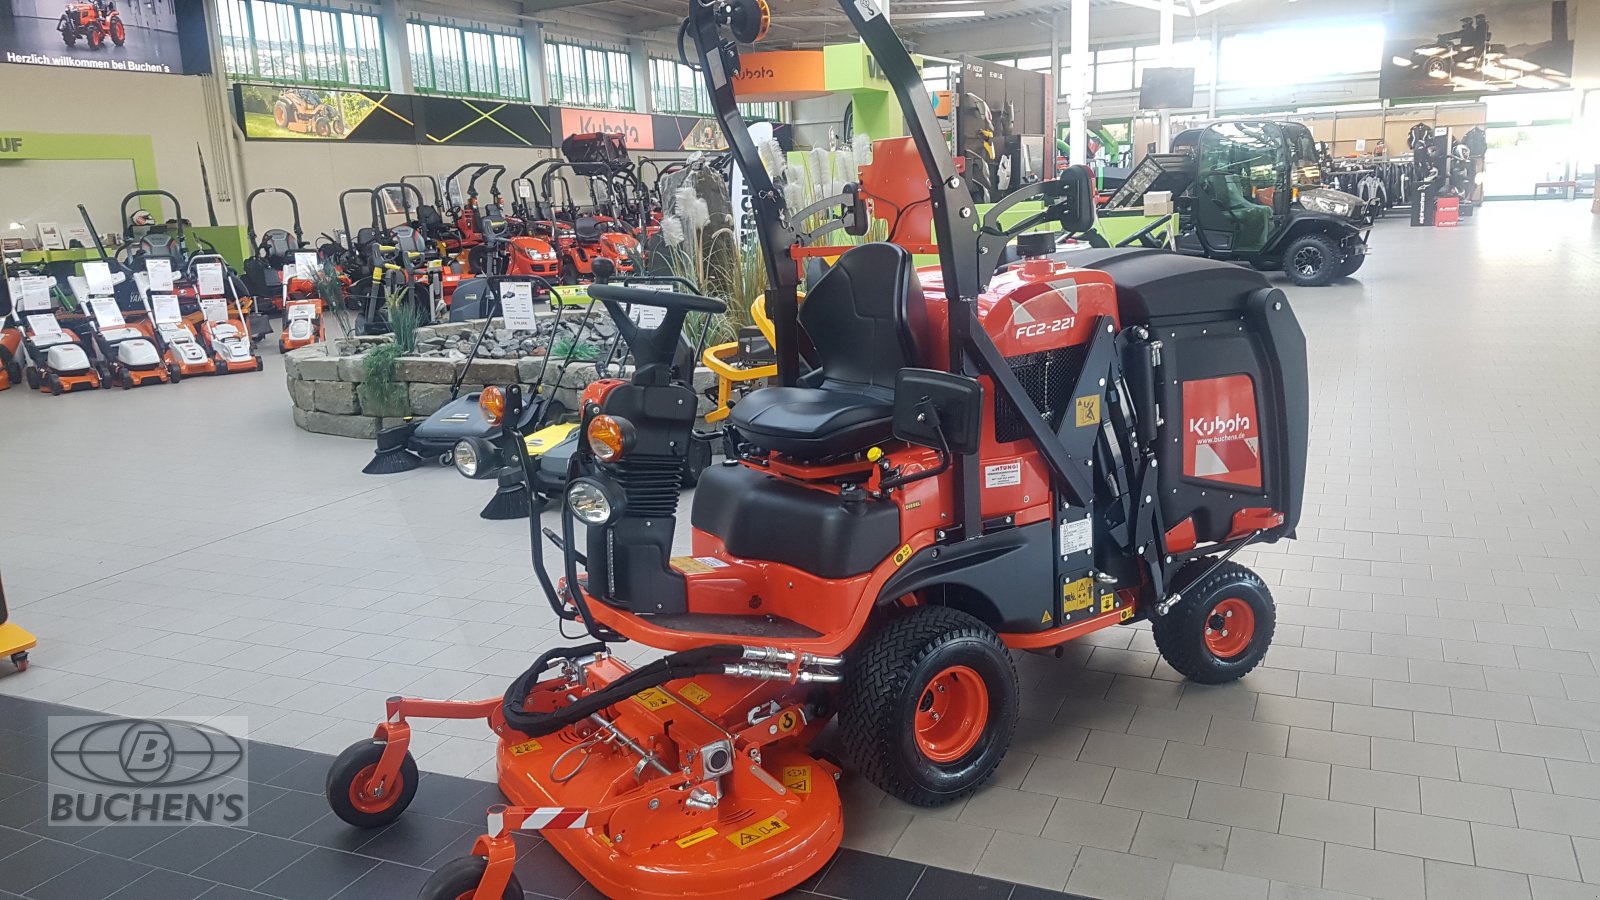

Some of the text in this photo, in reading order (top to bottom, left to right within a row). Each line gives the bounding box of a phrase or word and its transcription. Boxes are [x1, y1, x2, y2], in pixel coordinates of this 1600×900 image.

[7, 52, 50, 65] Herzlich
[51, 56, 109, 69] willkommen
[111, 59, 126, 70] bei
[1015, 316, 1075, 340] FC2-221
[1189, 413, 1250, 436] Kubota
[1196, 432, 1246, 445] www.buchens.de
